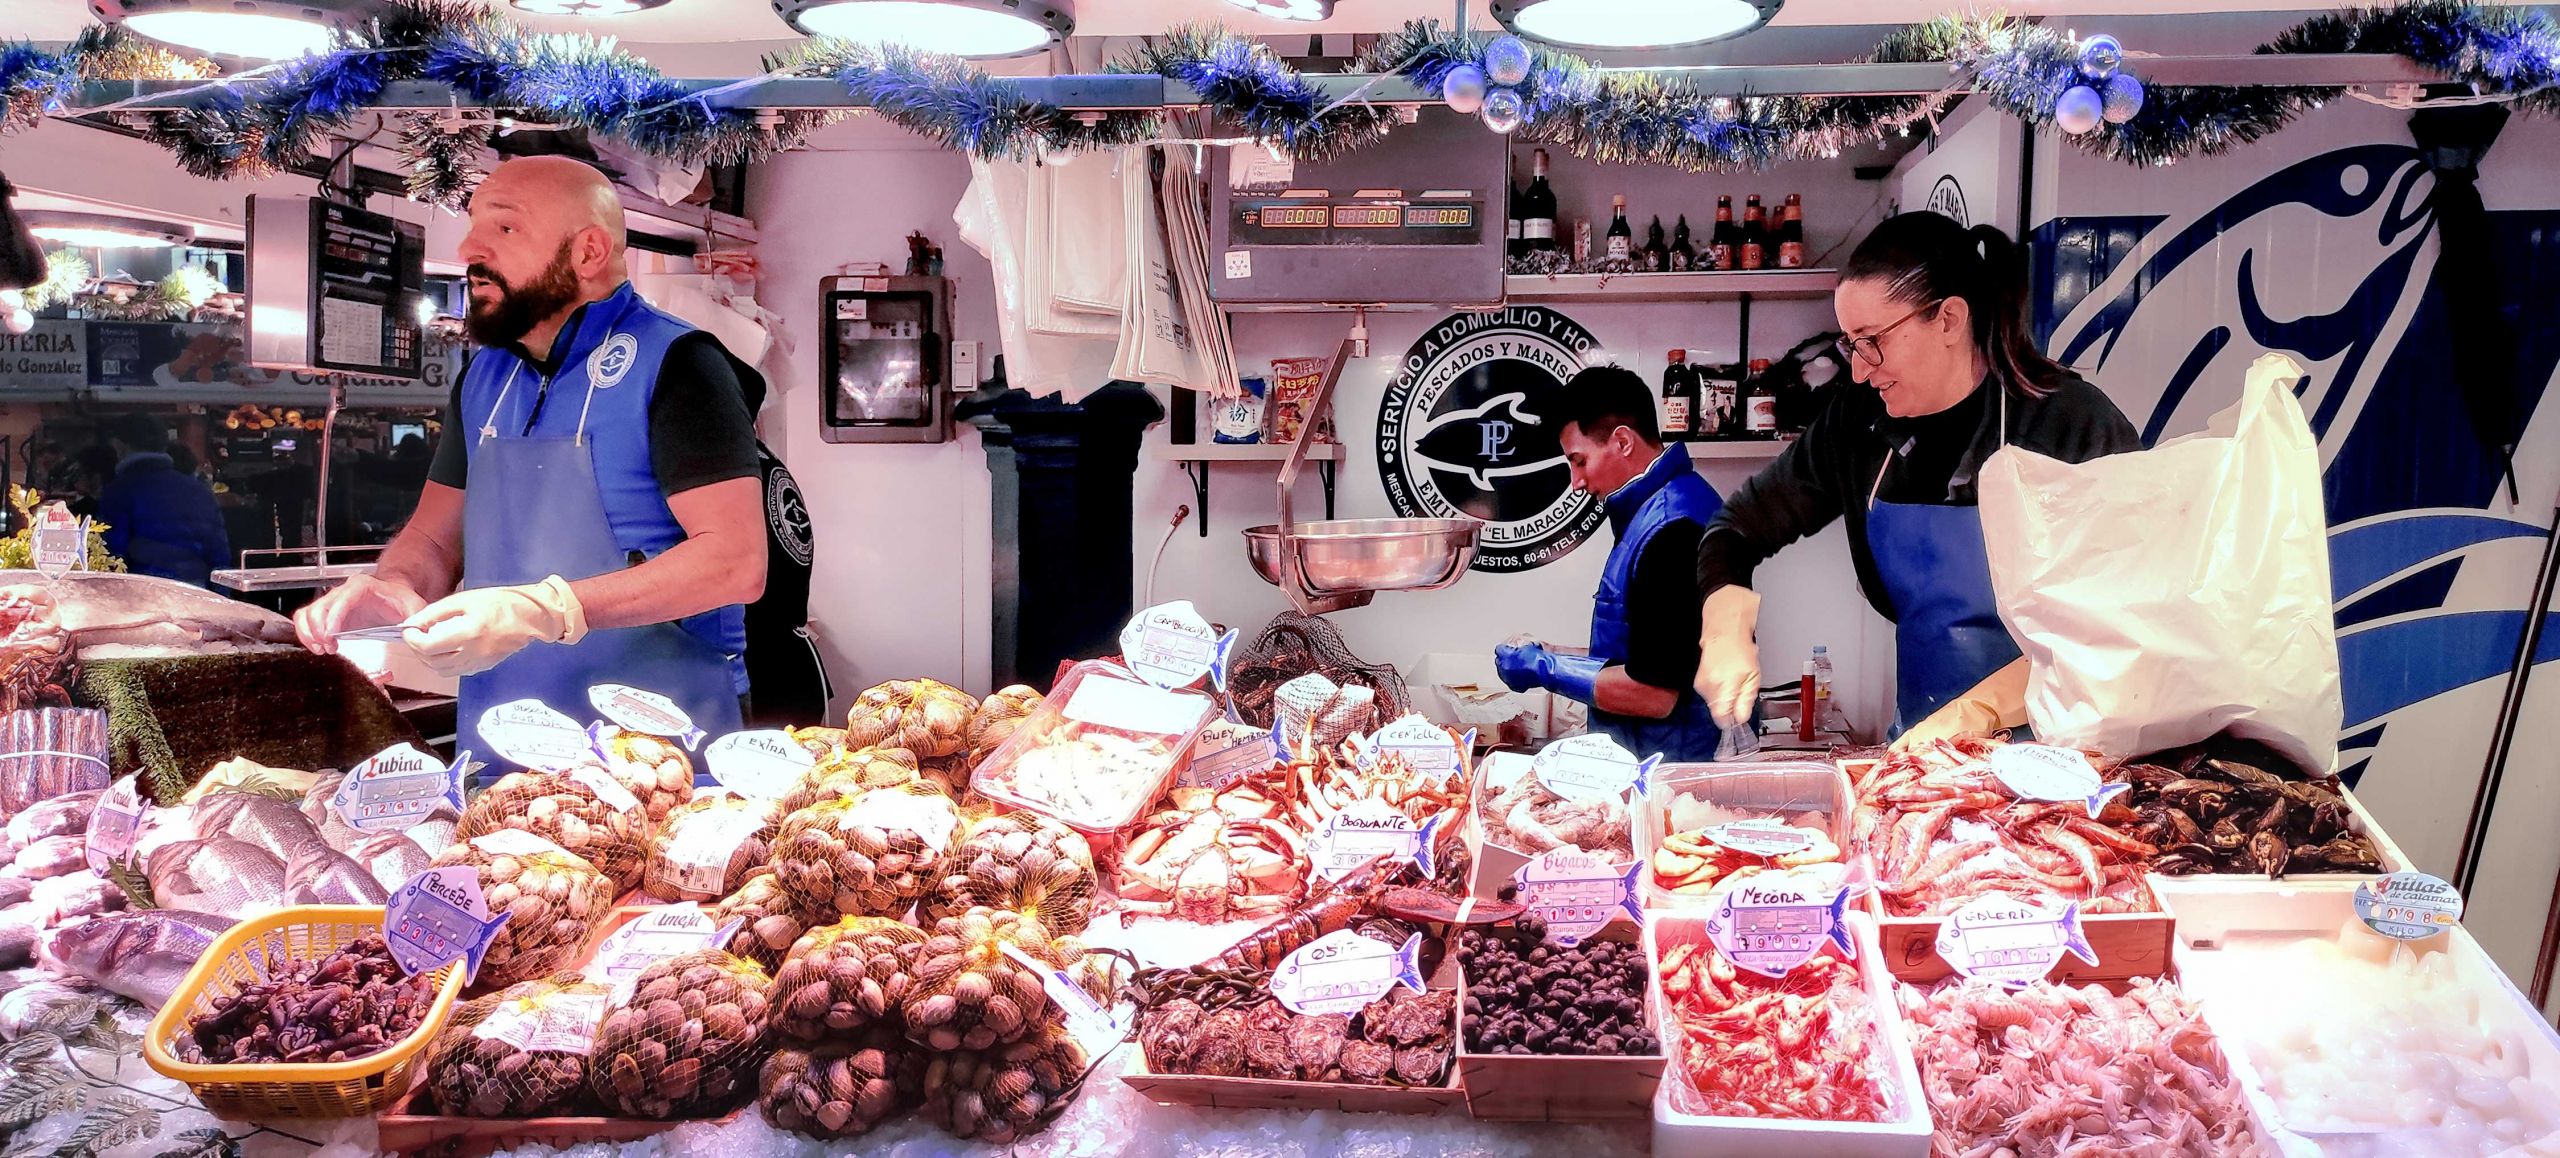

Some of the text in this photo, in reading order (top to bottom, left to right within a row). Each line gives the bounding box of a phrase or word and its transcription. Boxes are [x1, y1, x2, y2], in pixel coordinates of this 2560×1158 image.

[1381, 355, 1424, 452] SERVICIO
[1424, 340, 1440, 358] A
[1438, 308, 1541, 344] DOMICILIO
[1549, 316, 1562, 333] Y
[1417, 344, 1495, 413] PESCADOS
[1500, 342, 1511, 356] Y
[1524, 546, 1552, 564] 60-61
[1553, 529, 1583, 552] TELF:
[1581, 513, 1598, 531] 670
[749, 737, 788, 758] EXTRA
[1200, 728, 1235, 745] BUEY
[362, 753, 422, 779] Lubina
[426, 872, 473, 911] PERCEBE
